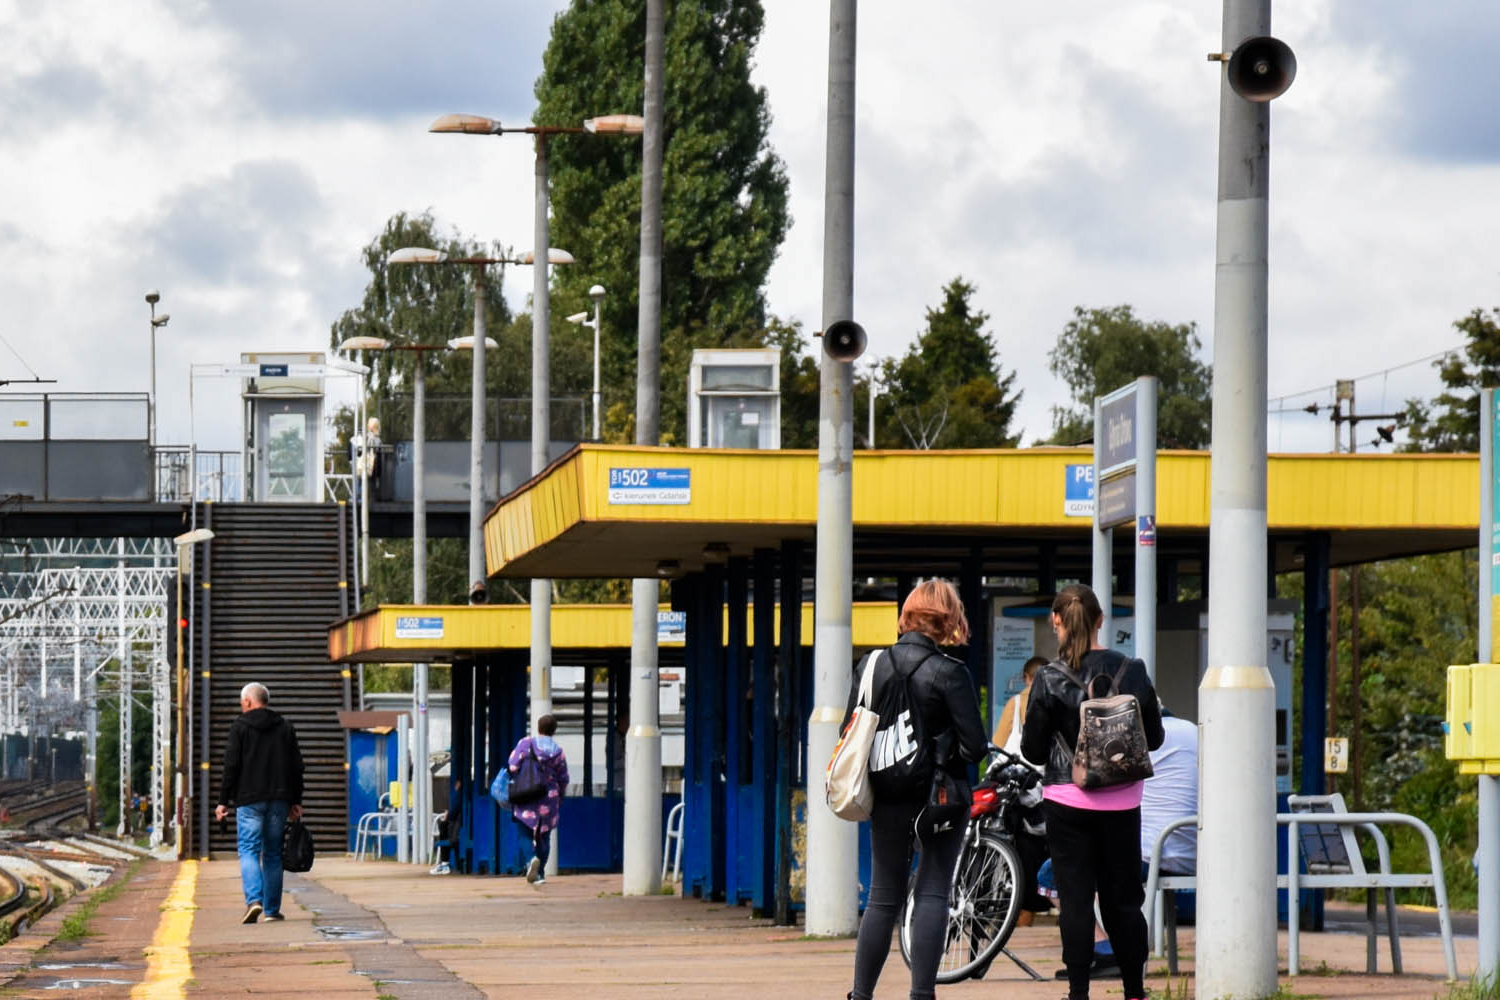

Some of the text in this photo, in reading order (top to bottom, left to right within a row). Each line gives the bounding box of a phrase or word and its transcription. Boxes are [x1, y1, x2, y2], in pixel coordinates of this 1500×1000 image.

[622, 469, 649, 486] 502
[1329, 740, 1341, 754] 15
[1331, 756, 1338, 769] 8
